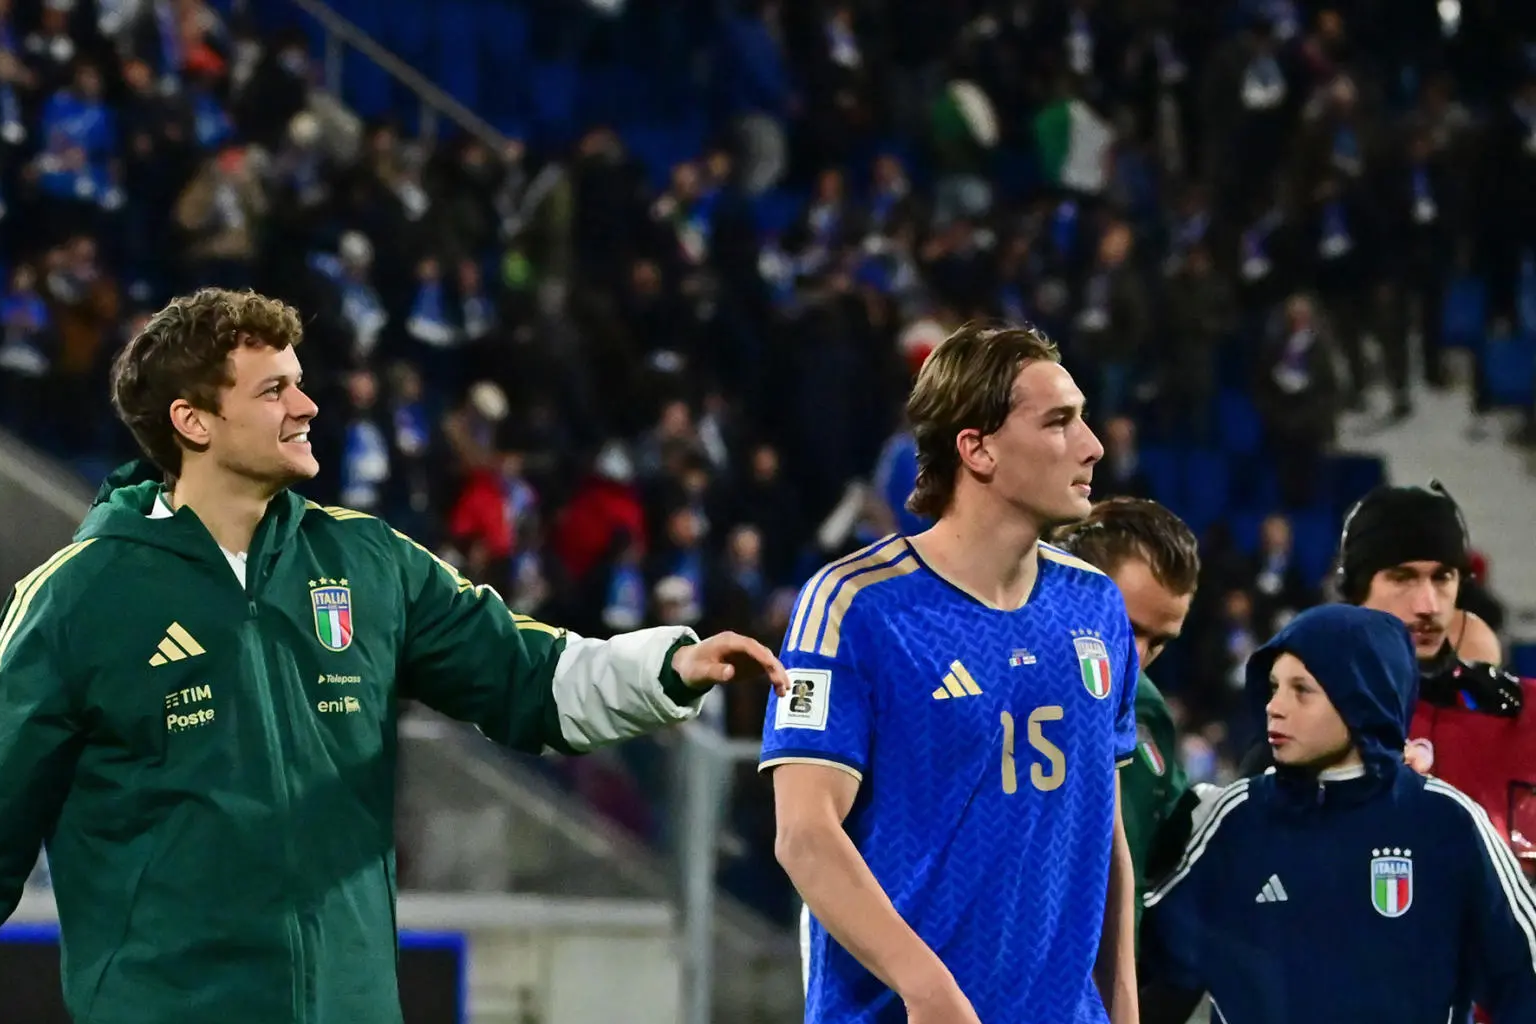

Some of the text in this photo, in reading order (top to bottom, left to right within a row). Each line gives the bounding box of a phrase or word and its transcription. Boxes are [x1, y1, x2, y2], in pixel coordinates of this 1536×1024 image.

[315, 592, 347, 605] ITALIA
[326, 674, 361, 685] Telepass
[180, 684, 212, 704] TIM
[317, 697, 343, 713] eni
[167, 709, 215, 730] Poste
[1000, 705, 1066, 795] 15
[1374, 861, 1410, 875] ITALIA
